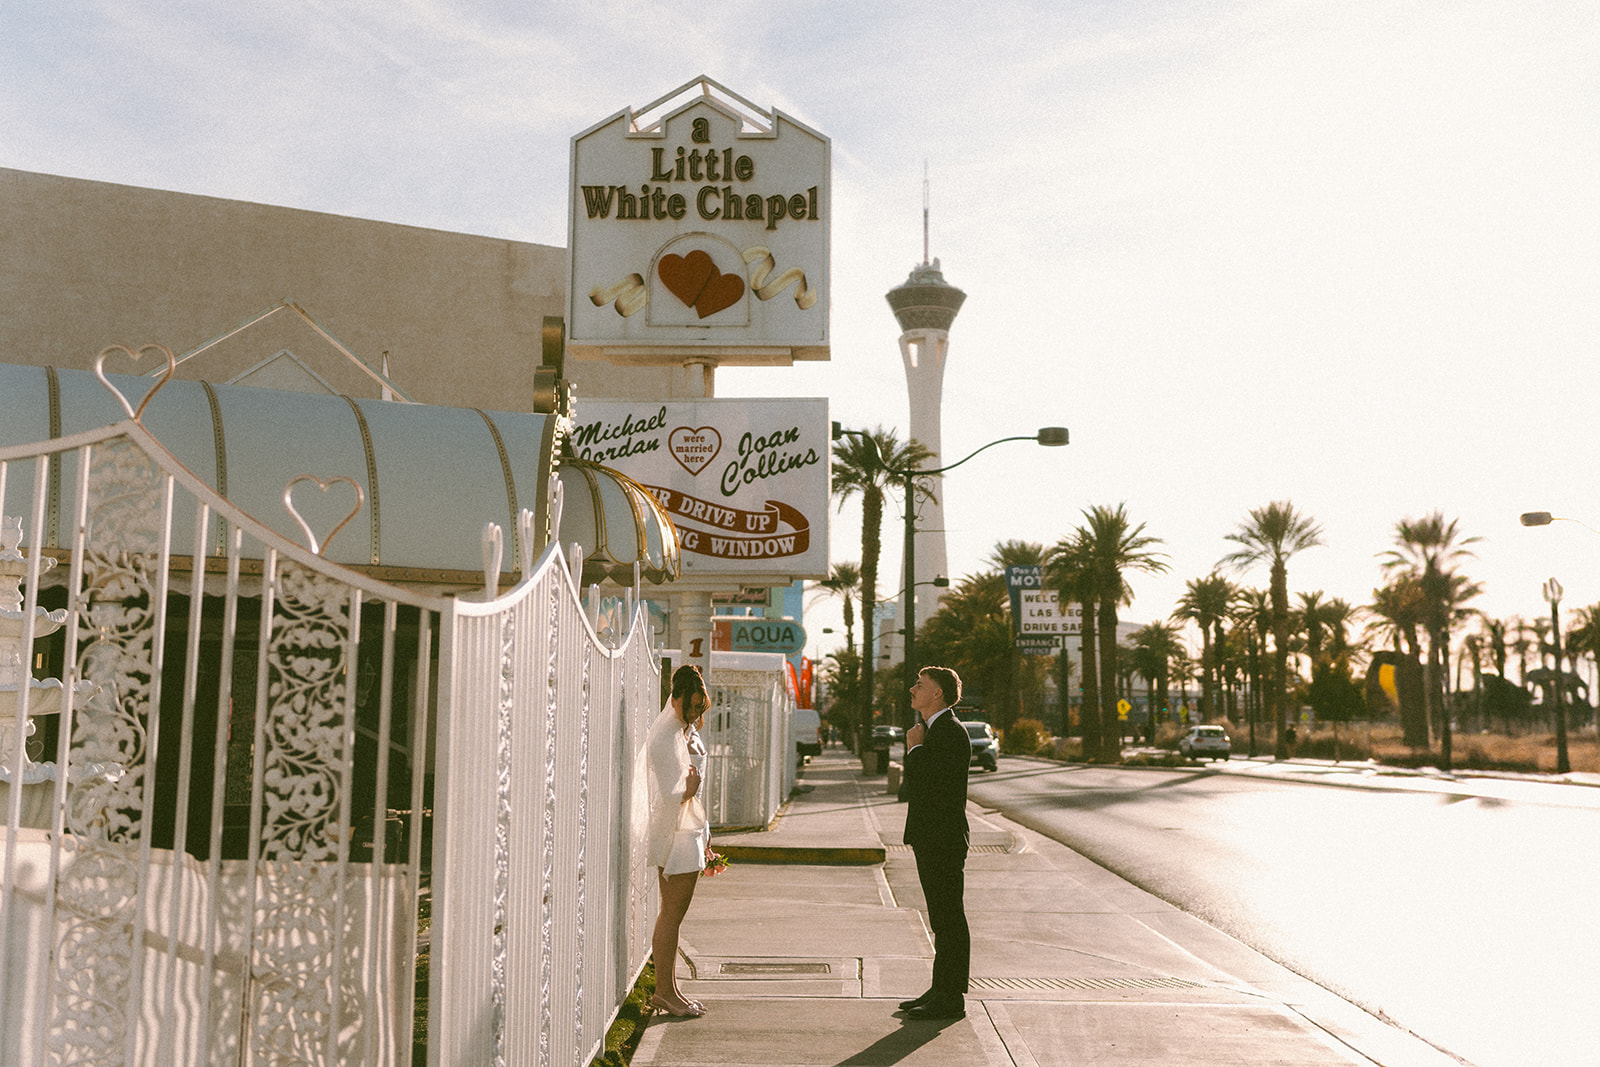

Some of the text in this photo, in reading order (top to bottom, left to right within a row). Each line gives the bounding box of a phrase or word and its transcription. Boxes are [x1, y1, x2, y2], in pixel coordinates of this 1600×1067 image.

[691, 117, 711, 143] a
[650, 146, 754, 182] Little
[581, 184, 819, 231] White Chapel
[573, 405, 667, 447] Michael
[675, 443, 713, 453] married
[683, 434, 706, 443] were
[739, 426, 801, 470] Joan
[683, 454, 705, 463] here
[720, 448, 820, 497] Collins
[678, 496, 736, 528] DRIVE
[745, 513, 770, 531] UP
[711, 536, 796, 557] WINDOW
[1010, 575, 1044, 587] MOT
[1024, 594, 1058, 603] WELC
[1029, 608, 1053, 617] LAS
[735, 626, 796, 645] AQUA
[1023, 622, 1083, 632] DRIVE SAF
